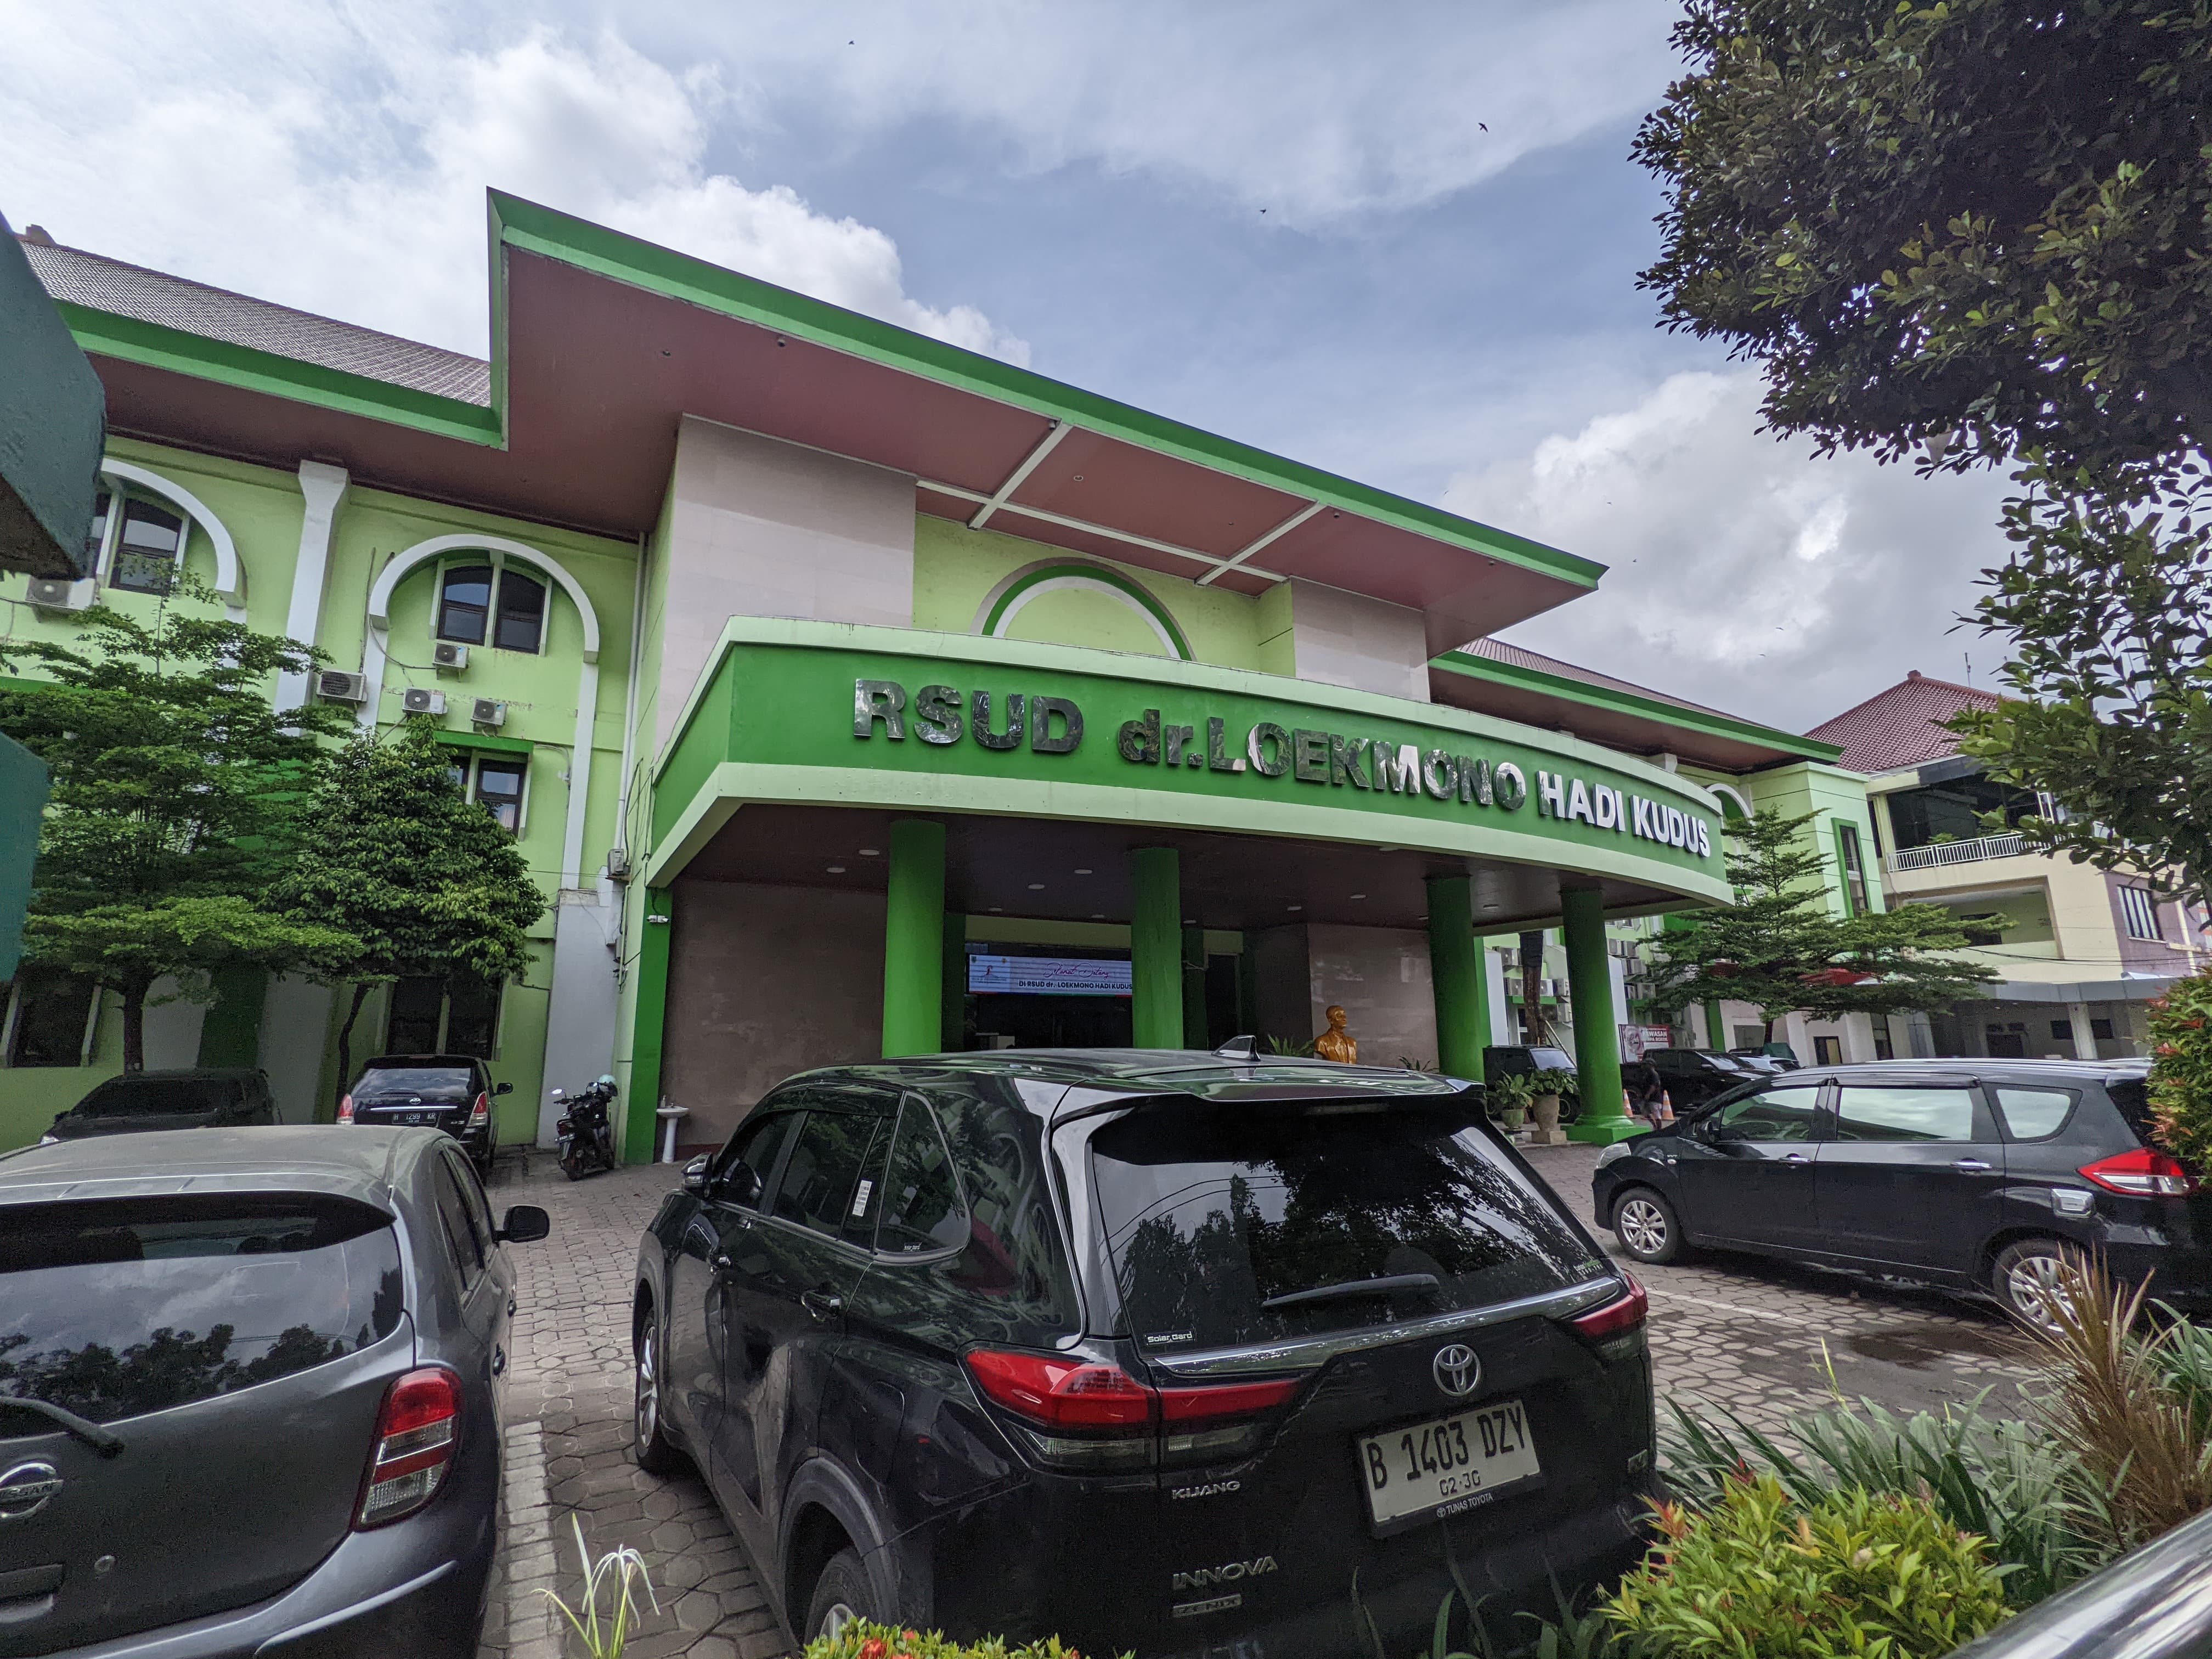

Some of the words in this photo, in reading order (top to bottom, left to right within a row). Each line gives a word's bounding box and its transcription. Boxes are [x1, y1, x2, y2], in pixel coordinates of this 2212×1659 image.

[854, 678, 1085, 753] RSUD
[1536, 770, 1626, 832] HADI
[1630, 794, 1711, 858] KUDUS
[1148, 1335, 1170, 1343] Solar
[1171, 1330, 1193, 1340] Gard
[1366, 1441, 1388, 1490] B
[1401, 1420, 1469, 1481] 1403
[1477, 1406, 1525, 1459] DZY
[1172, 1481, 1241, 1499] KIJANG
[1446, 1500, 1468, 1515] TUNAS
[1468, 1492, 1494, 1508] TOYOTA
[1172, 1556, 1279, 1590] INNOVA
